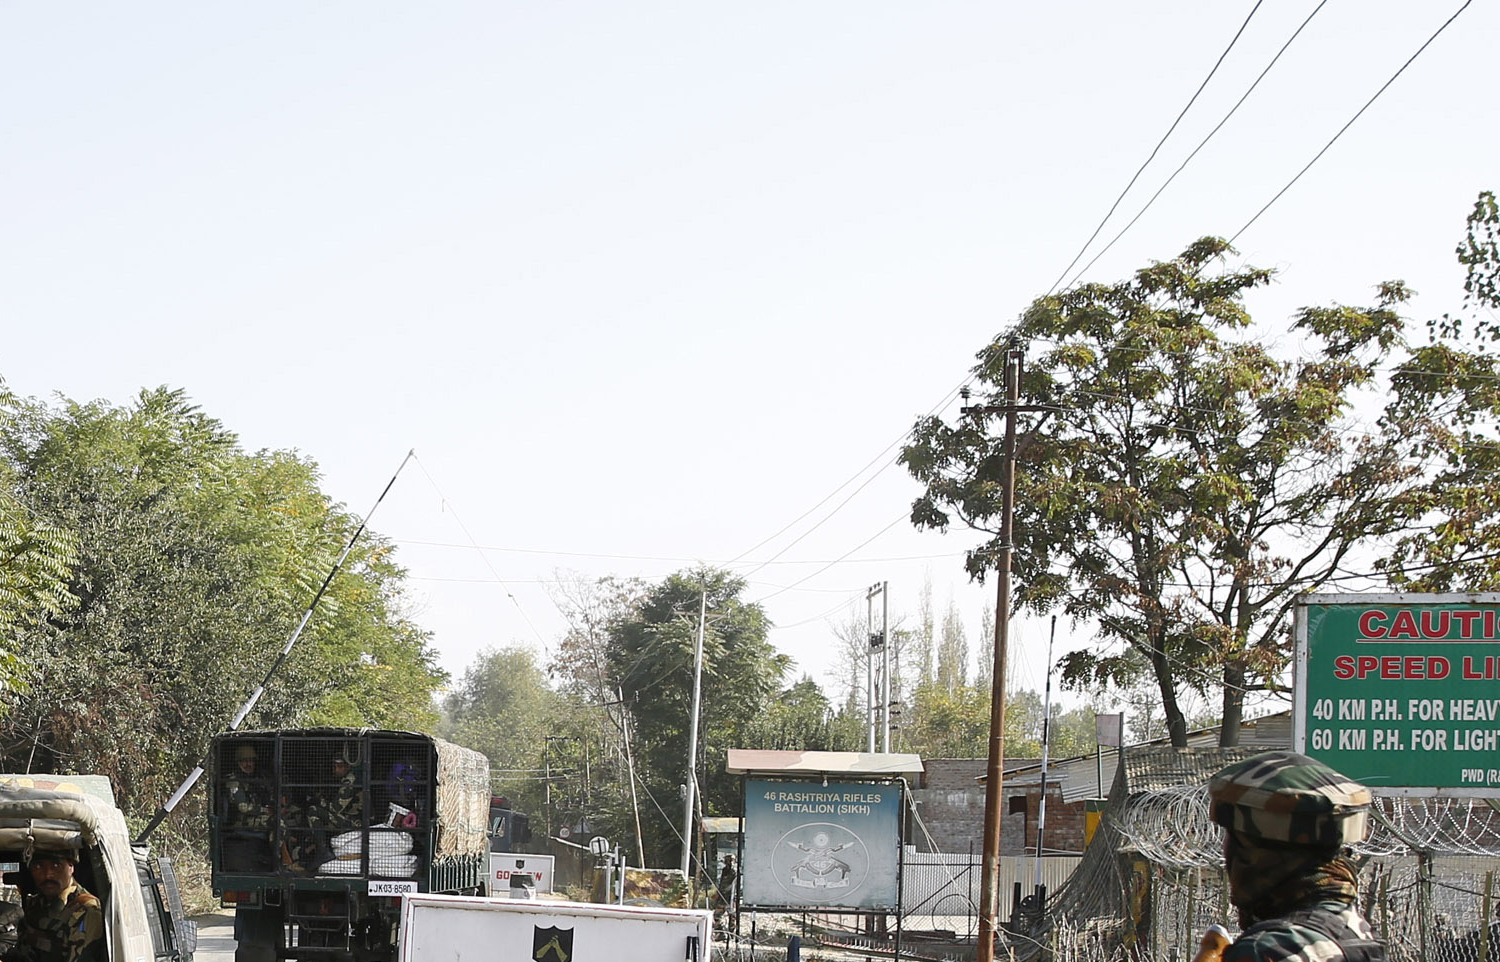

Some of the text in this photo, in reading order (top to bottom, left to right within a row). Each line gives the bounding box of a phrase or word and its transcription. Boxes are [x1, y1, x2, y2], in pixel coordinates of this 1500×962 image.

[1358, 610, 1500, 639] CAUTI
[1333, 655, 1500, 680] SPEED LI
[1313, 699, 1500, 721] 40 KM P.H. FOR HEAV
[1311, 729, 1333, 751] 60
[1338, 729, 1366, 751] KM
[1373, 729, 1404, 751] P.H.
[1411, 729, 1448, 751] FOR
[1461, 768, 1500, 786] PWD (R
[763, 792, 882, 804] 46 RASHTRIYA RIFLES
[774, 803, 871, 816] BATTALION (SIKH)
[496, 871, 510, 880] GO
